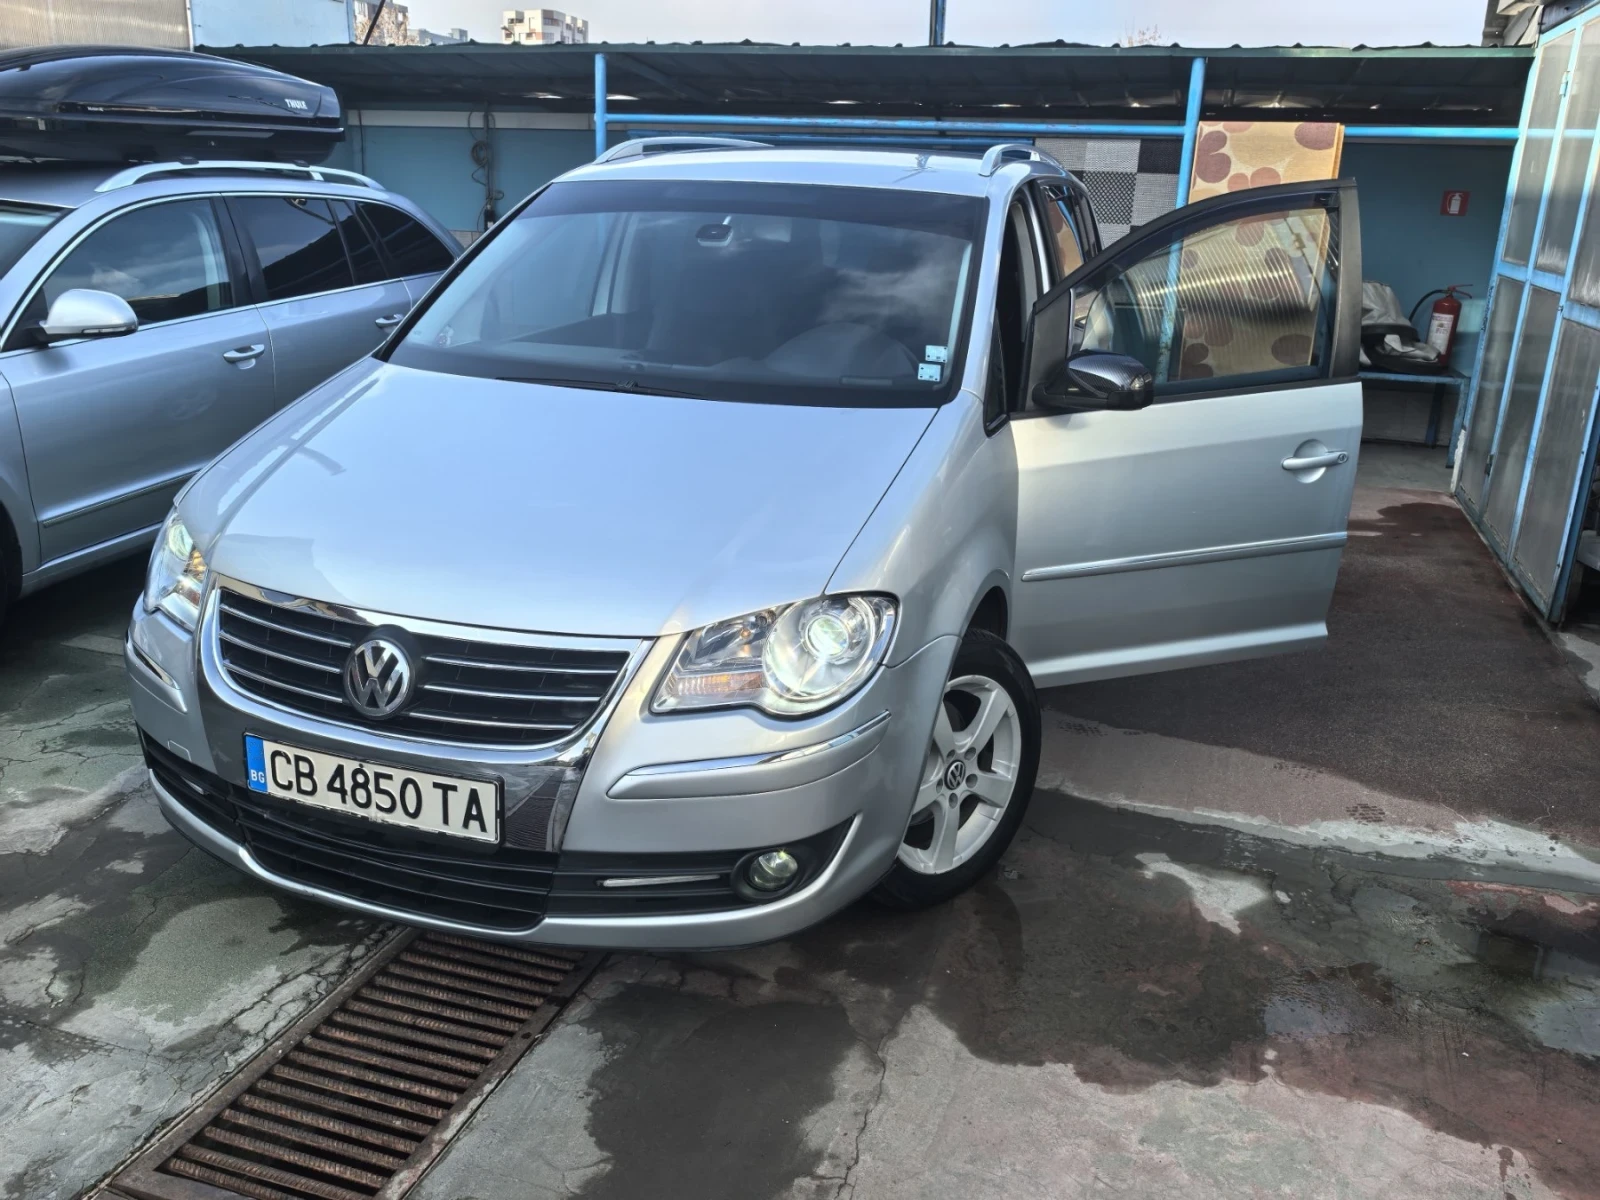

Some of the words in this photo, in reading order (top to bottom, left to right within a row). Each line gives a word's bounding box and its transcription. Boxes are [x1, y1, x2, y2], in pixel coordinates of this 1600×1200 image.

[250, 769, 265, 783] BG
[270, 750, 318, 796] CB
[326, 764, 423, 819] 4850
[432, 781, 488, 833] TA
